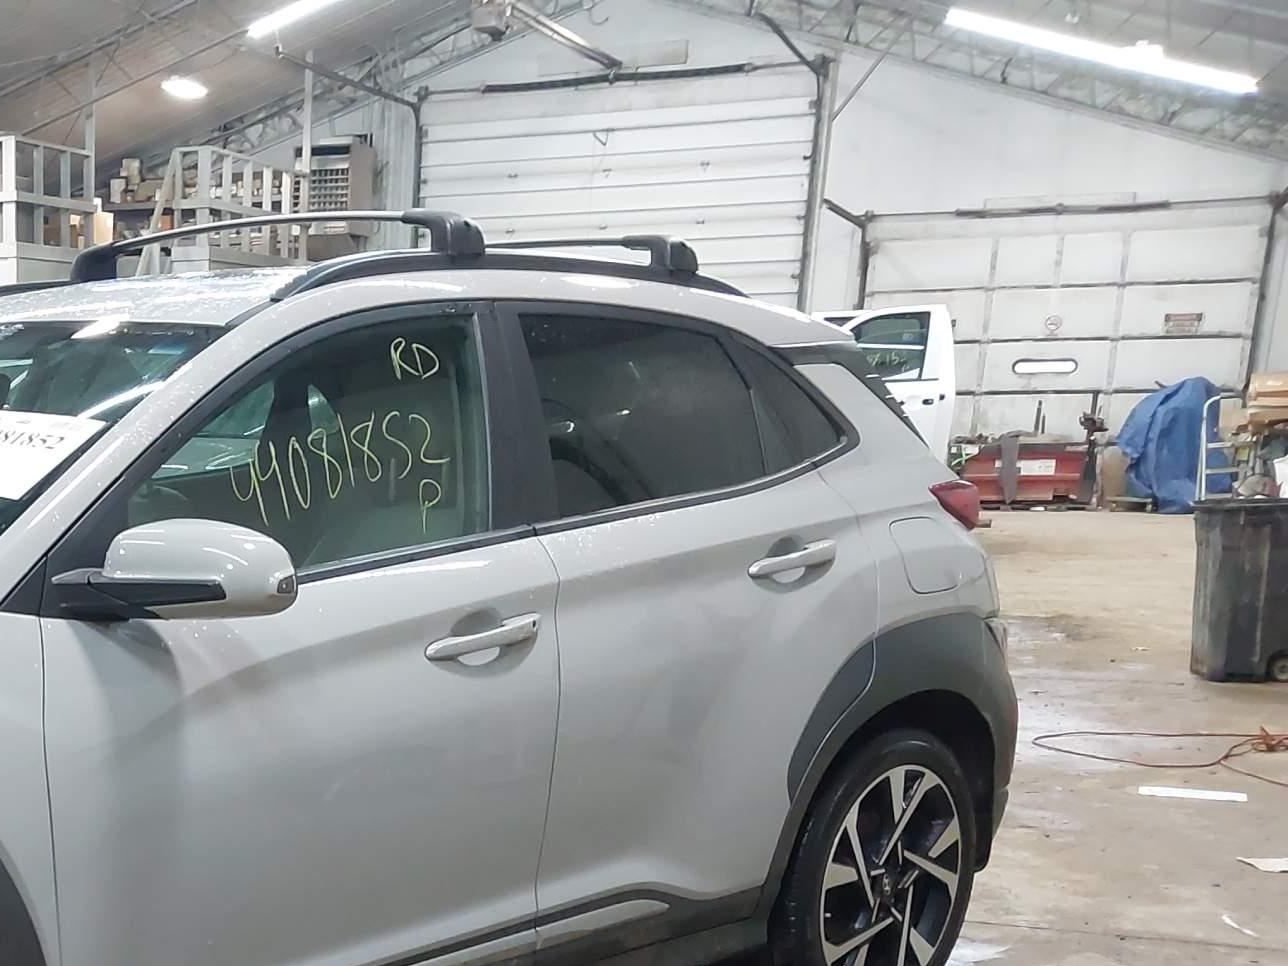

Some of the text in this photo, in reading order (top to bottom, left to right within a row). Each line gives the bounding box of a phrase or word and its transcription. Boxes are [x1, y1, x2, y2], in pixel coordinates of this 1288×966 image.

[390, 337, 440, 381] RD
[229, 410, 451, 527] 44081852
[418, 478, 442, 534] P
